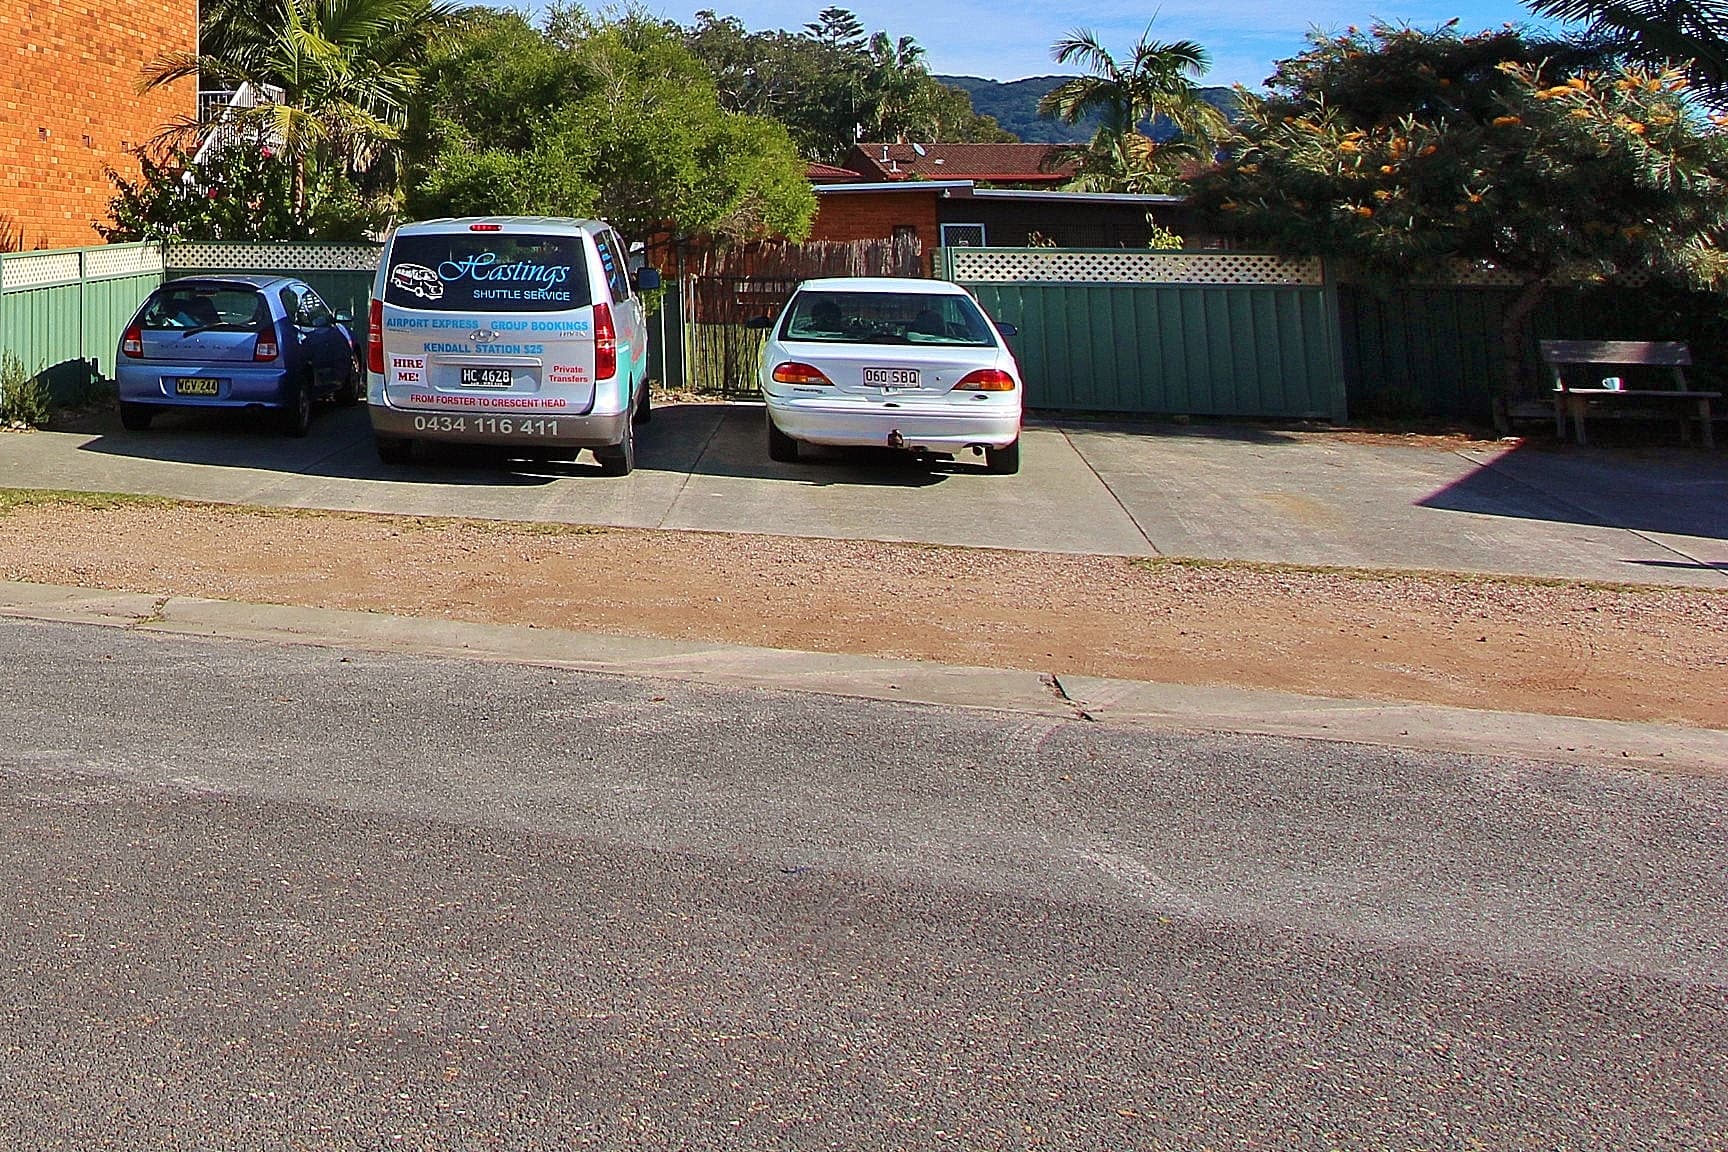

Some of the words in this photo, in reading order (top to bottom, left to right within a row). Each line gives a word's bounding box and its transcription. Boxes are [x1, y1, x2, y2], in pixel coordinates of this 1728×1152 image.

[438, 252, 570, 291] Hastings
[473, 289, 521, 300] SHUTTLE
[524, 290, 570, 301] SERVICE
[386, 318, 429, 328] AIRPORT
[432, 319, 479, 329] EXPRESS
[490, 320, 528, 330] GROUP
[531, 321, 589, 331] BOOKINGS
[423, 343, 471, 353] KENDALL
[475, 344, 521, 354] STATION
[392, 358, 424, 369] HIRE
[553, 365, 583, 373] Private
[398, 372, 420, 382] ME!
[463, 369, 477, 383] HC
[481, 369, 510, 383] 4628
[549, 374, 589, 383] Transfers
[410, 394, 434, 404] FROM
[436, 395, 476, 406] FORSTER
[477, 397, 489, 407] TO
[491, 398, 539, 408] CRESCENT
[541, 399, 566, 408] HEAD
[414, 416, 466, 432] 0434
[474, 418, 513, 434] 116
[522, 419, 559, 436] 411
